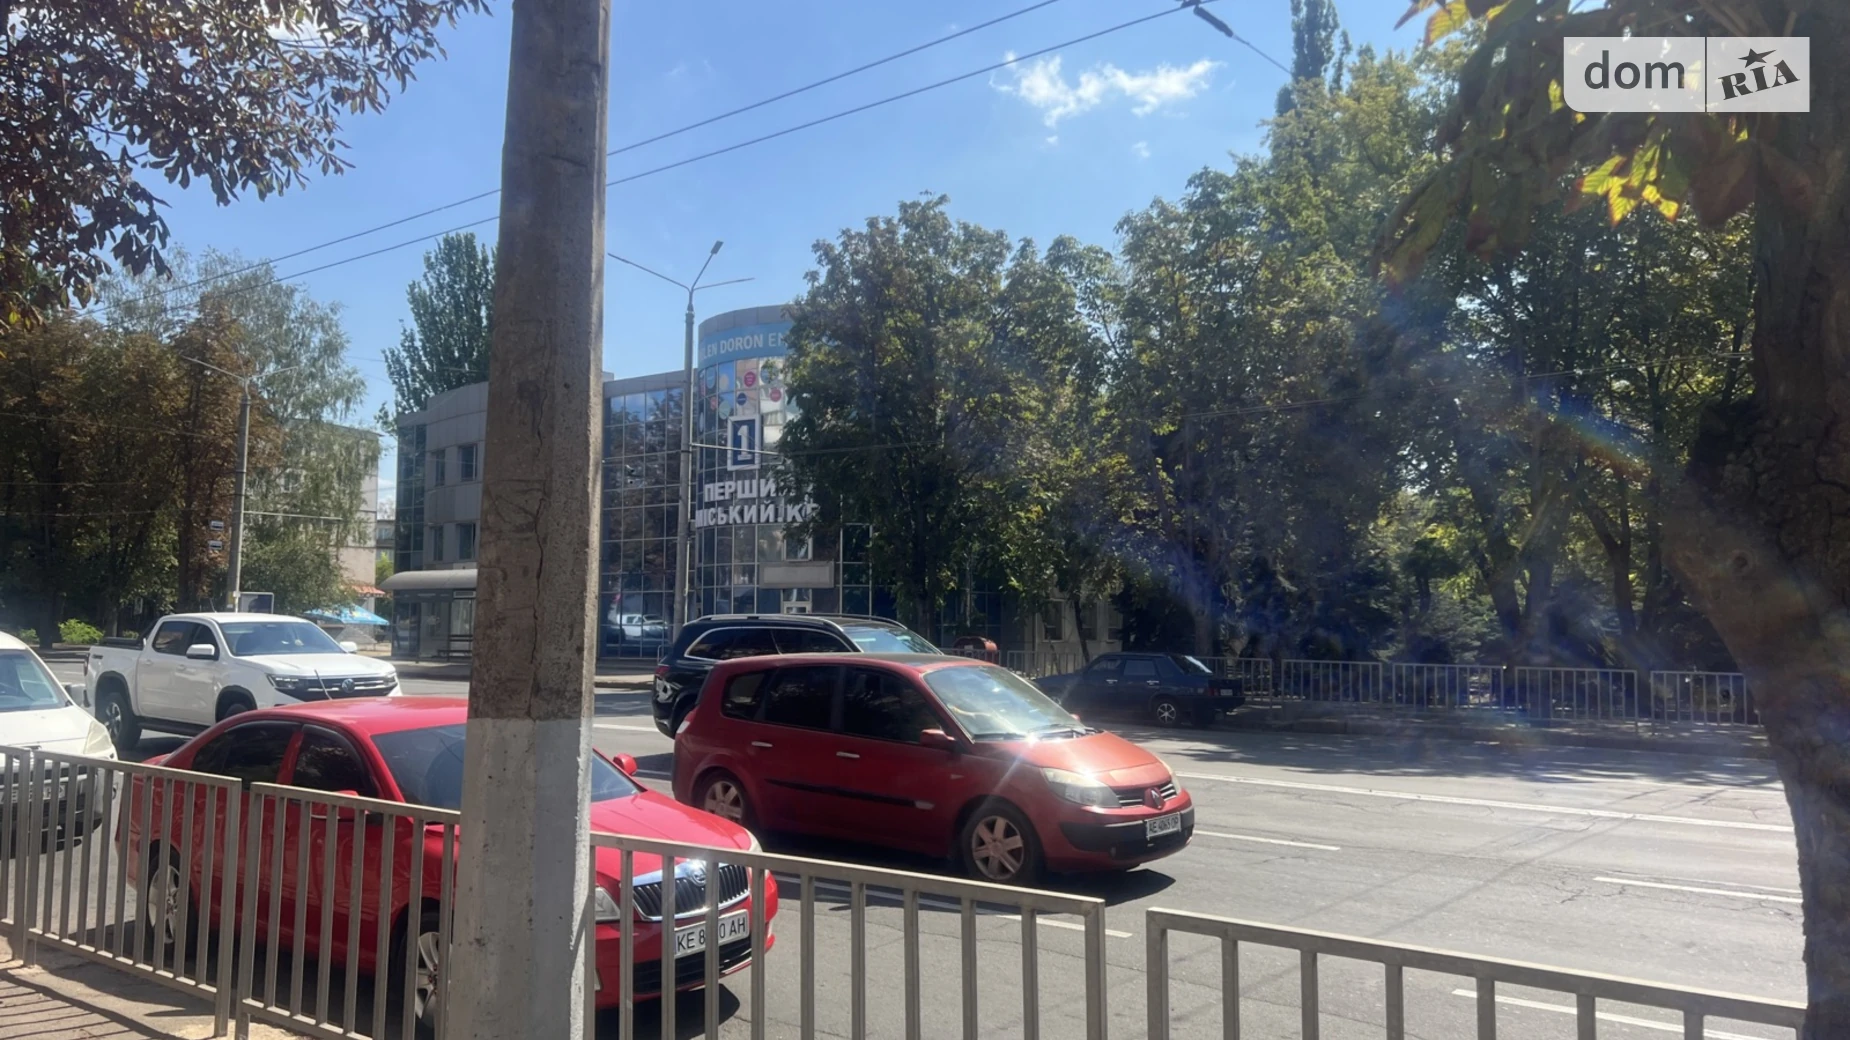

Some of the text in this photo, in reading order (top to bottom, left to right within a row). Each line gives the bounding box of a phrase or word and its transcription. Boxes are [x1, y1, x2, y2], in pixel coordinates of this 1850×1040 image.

[720, 334, 763, 354] DORON
[737, 425, 753, 461] 1
[677, 917, 746, 952] KE 80 AH
